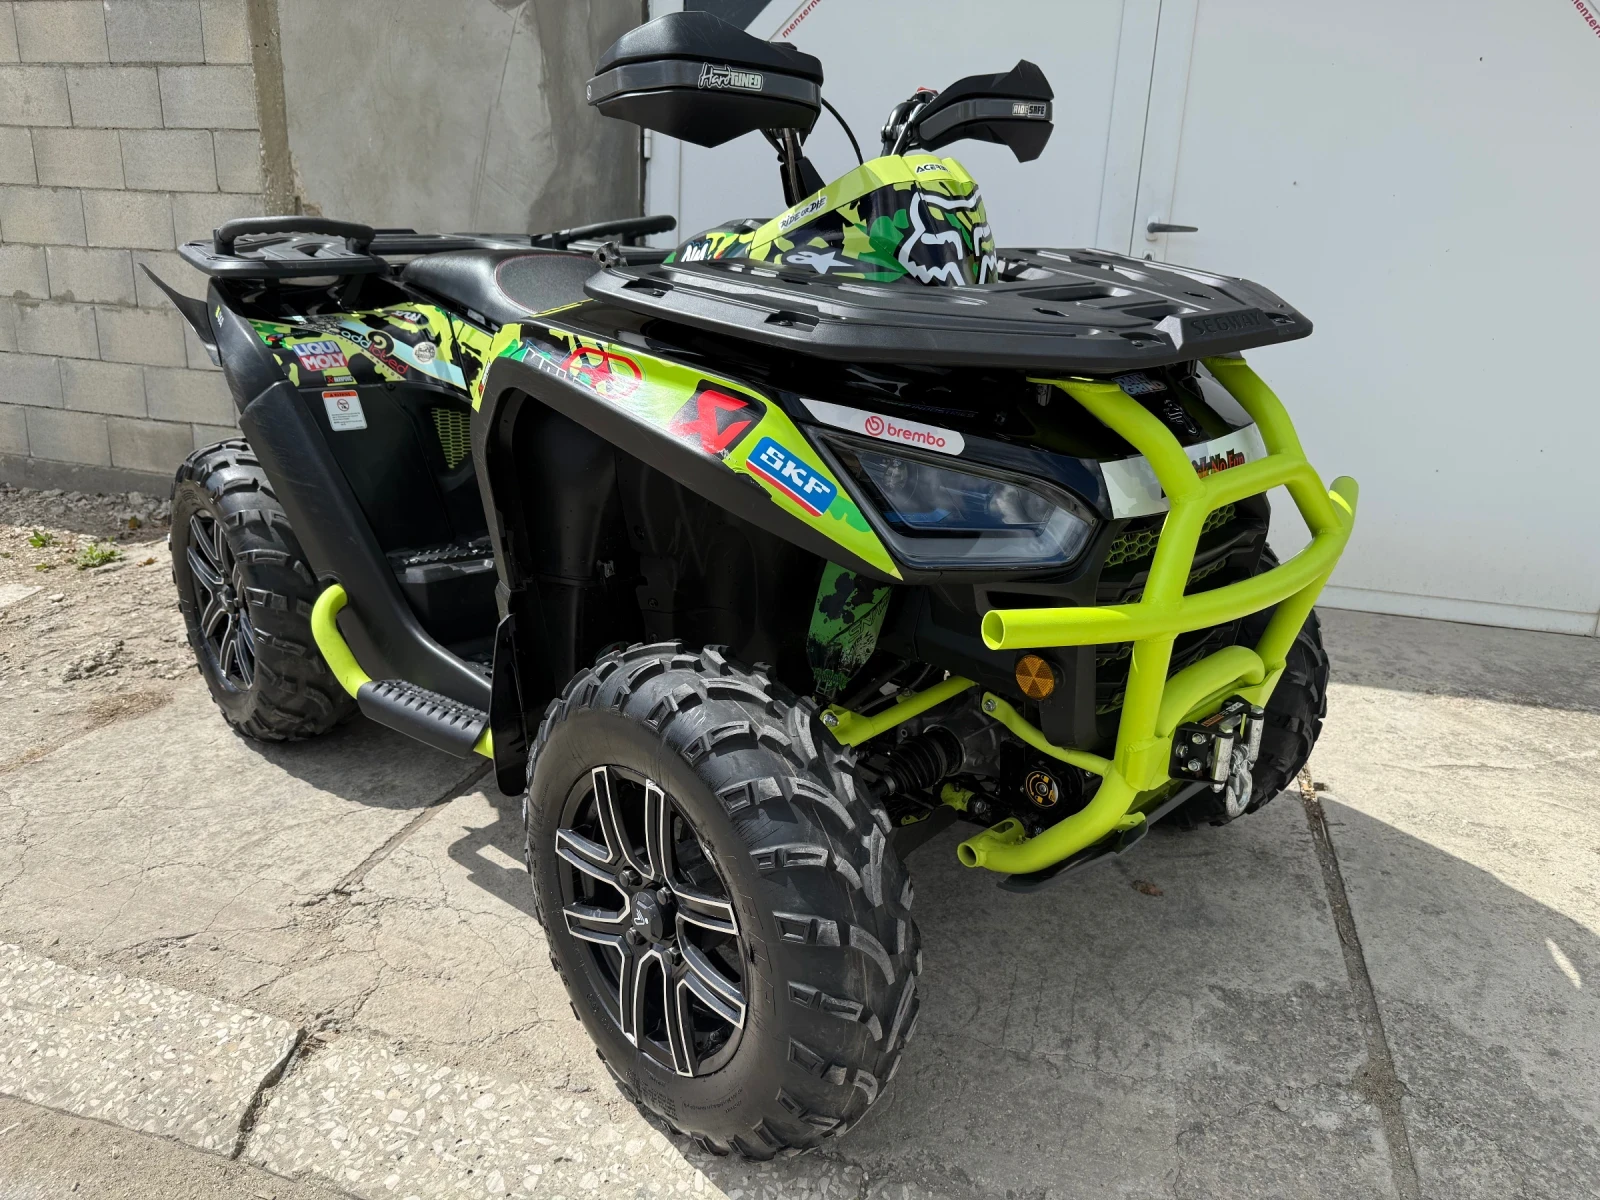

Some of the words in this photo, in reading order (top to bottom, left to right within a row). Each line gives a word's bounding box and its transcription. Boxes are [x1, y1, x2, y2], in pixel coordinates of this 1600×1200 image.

[1028, 104, 1045, 115] SAFE
[1190, 311, 1261, 336] SEGWAY
[293, 341, 341, 357] LIQUI
[301, 353, 346, 370] MOLY
[887, 423, 945, 448] brembo
[760, 446, 830, 494] SKF
